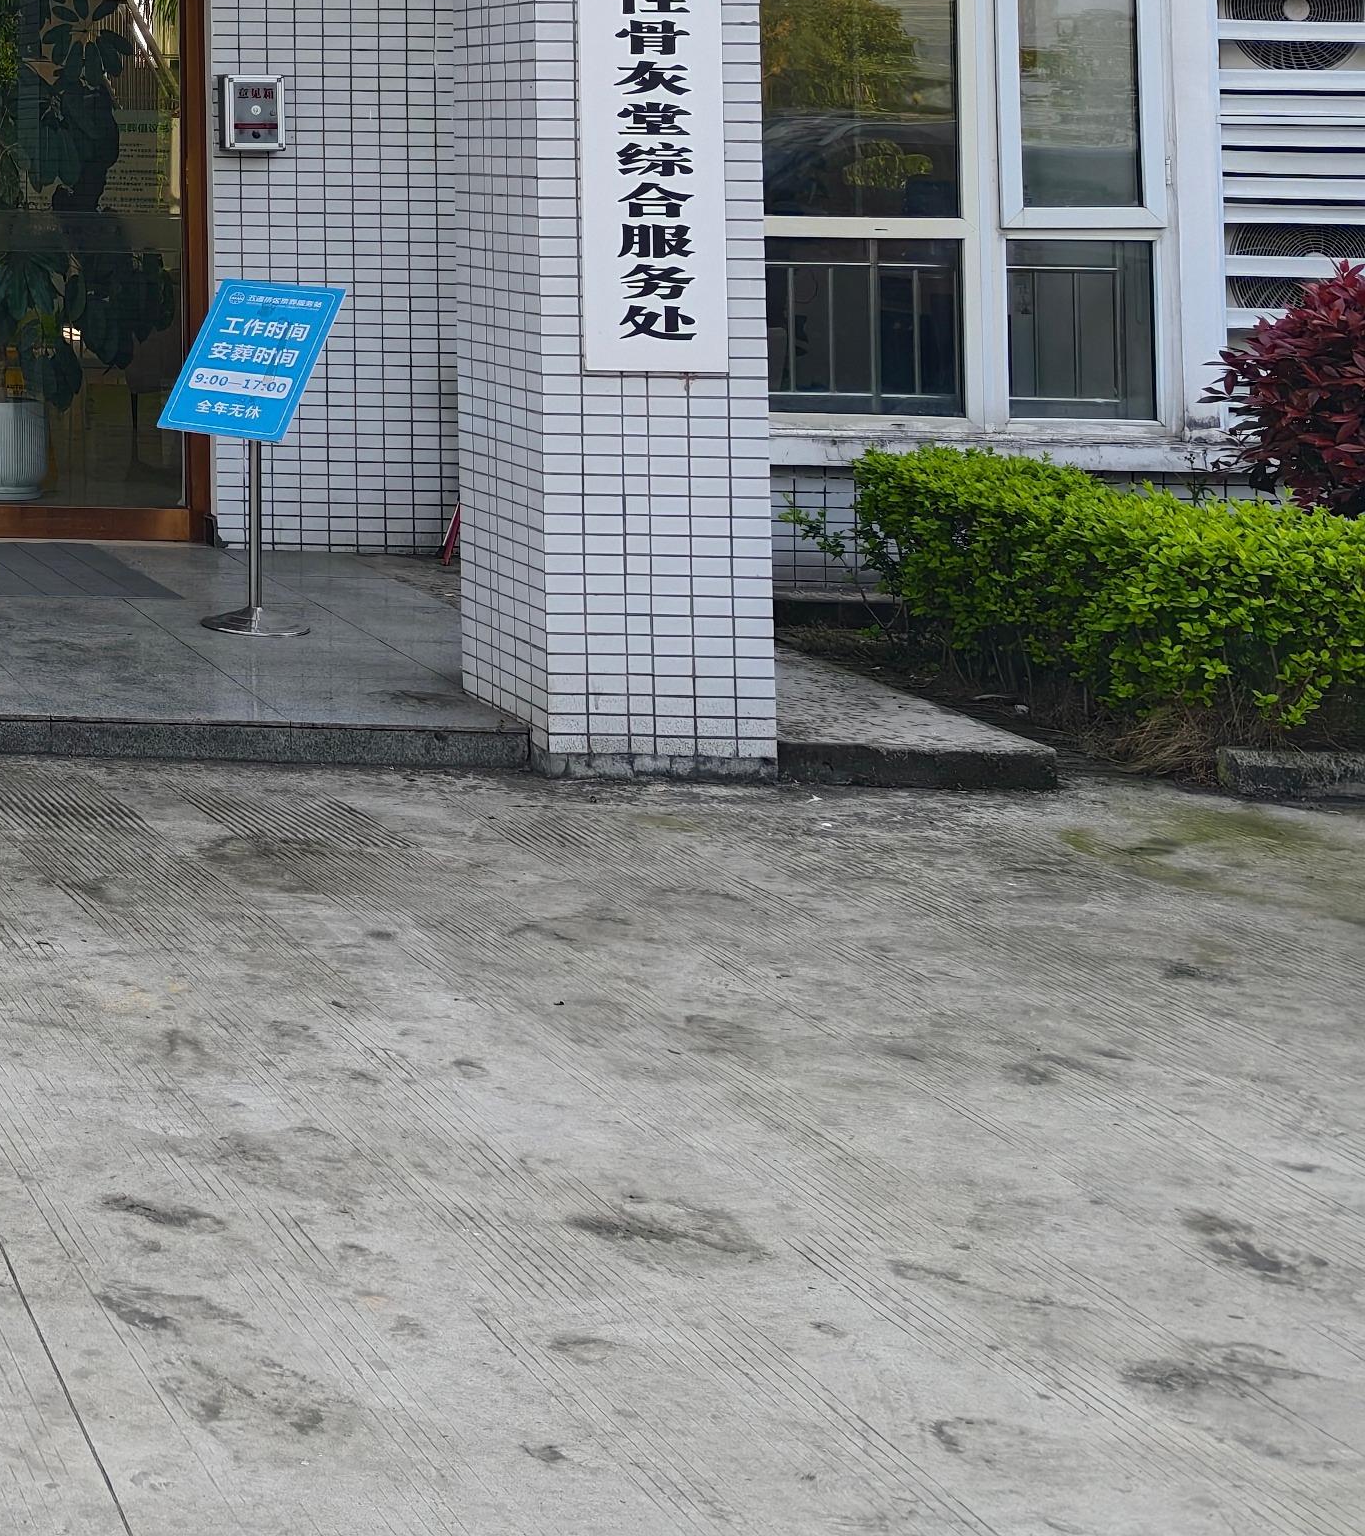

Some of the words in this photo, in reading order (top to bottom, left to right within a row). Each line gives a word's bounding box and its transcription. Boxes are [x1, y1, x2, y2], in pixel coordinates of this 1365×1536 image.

[237, 87, 274, 100] 意见箱
[219, 317, 311, 342] 工作时间
[207, 341, 300, 368] 安葬时间
[195, 399, 262, 420] 全年无休
